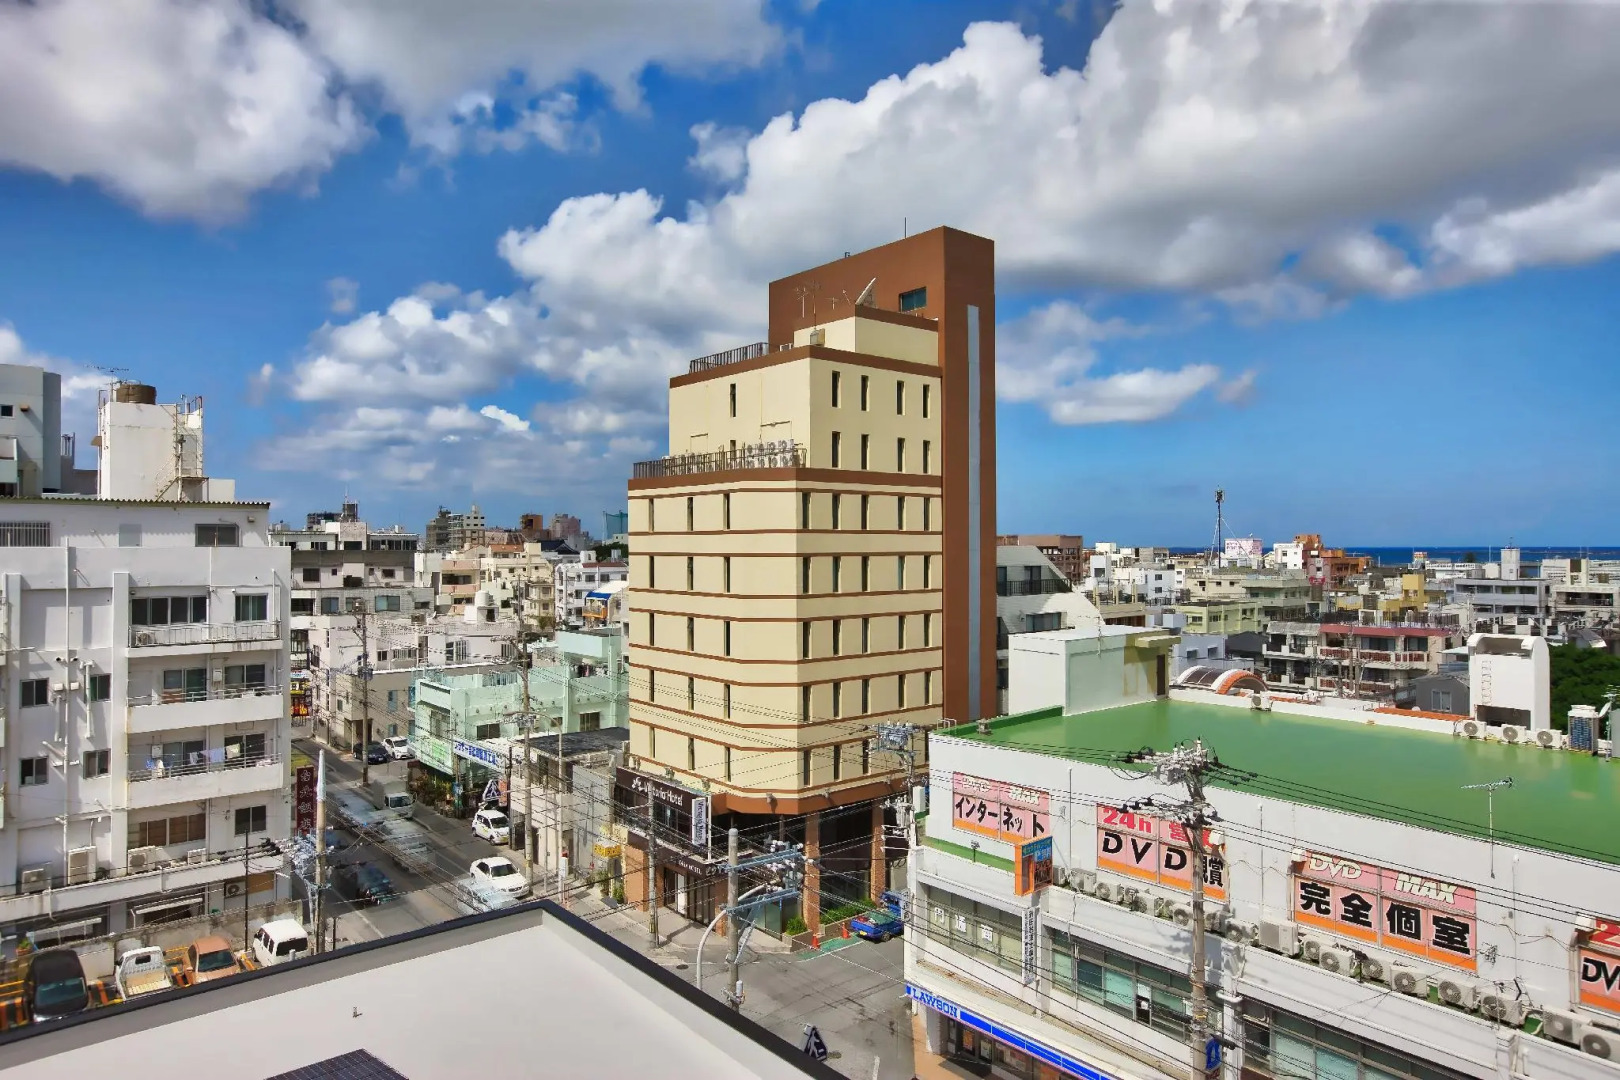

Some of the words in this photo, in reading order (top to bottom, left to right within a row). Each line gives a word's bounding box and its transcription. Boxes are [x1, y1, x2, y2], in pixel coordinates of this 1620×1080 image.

[955, 796, 1045, 837] インターネット
[1103, 807, 1152, 834] 24h
[1309, 853, 1362, 880] DVD
[1394, 872, 1458, 905] MAX
[1299, 881, 1471, 956] 完全個室
[912, 987, 958, 1018] LAWSON
